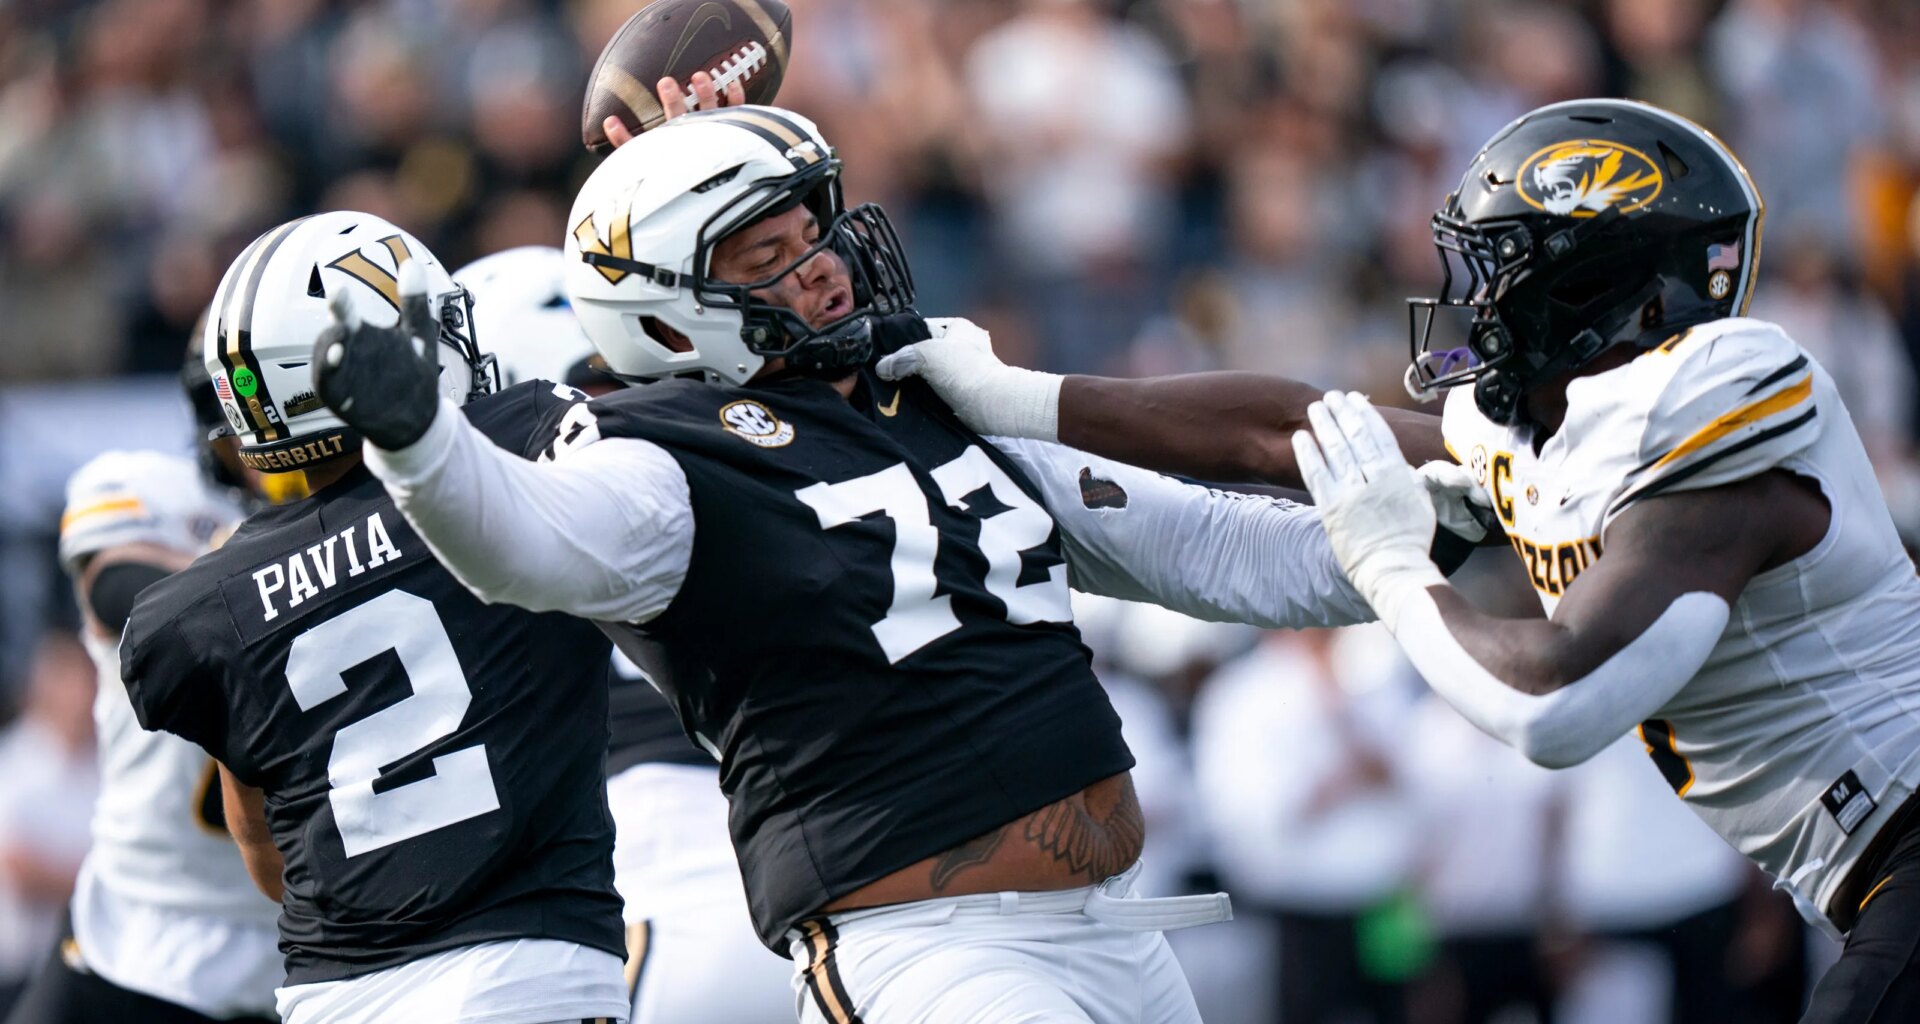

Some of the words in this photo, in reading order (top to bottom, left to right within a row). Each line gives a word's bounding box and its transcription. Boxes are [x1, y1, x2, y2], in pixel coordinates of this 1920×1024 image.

[1711, 273, 1729, 295] SEC
[235, 375, 253, 388] C2P
[263, 405, 281, 424] 2
[724, 403, 776, 435] SEC
[1492, 451, 1515, 528] C
[252, 511, 402, 622] PAVIA
[794, 444, 1074, 665] 72
[284, 588, 500, 859] 2
[1831, 782, 1850, 805] M
